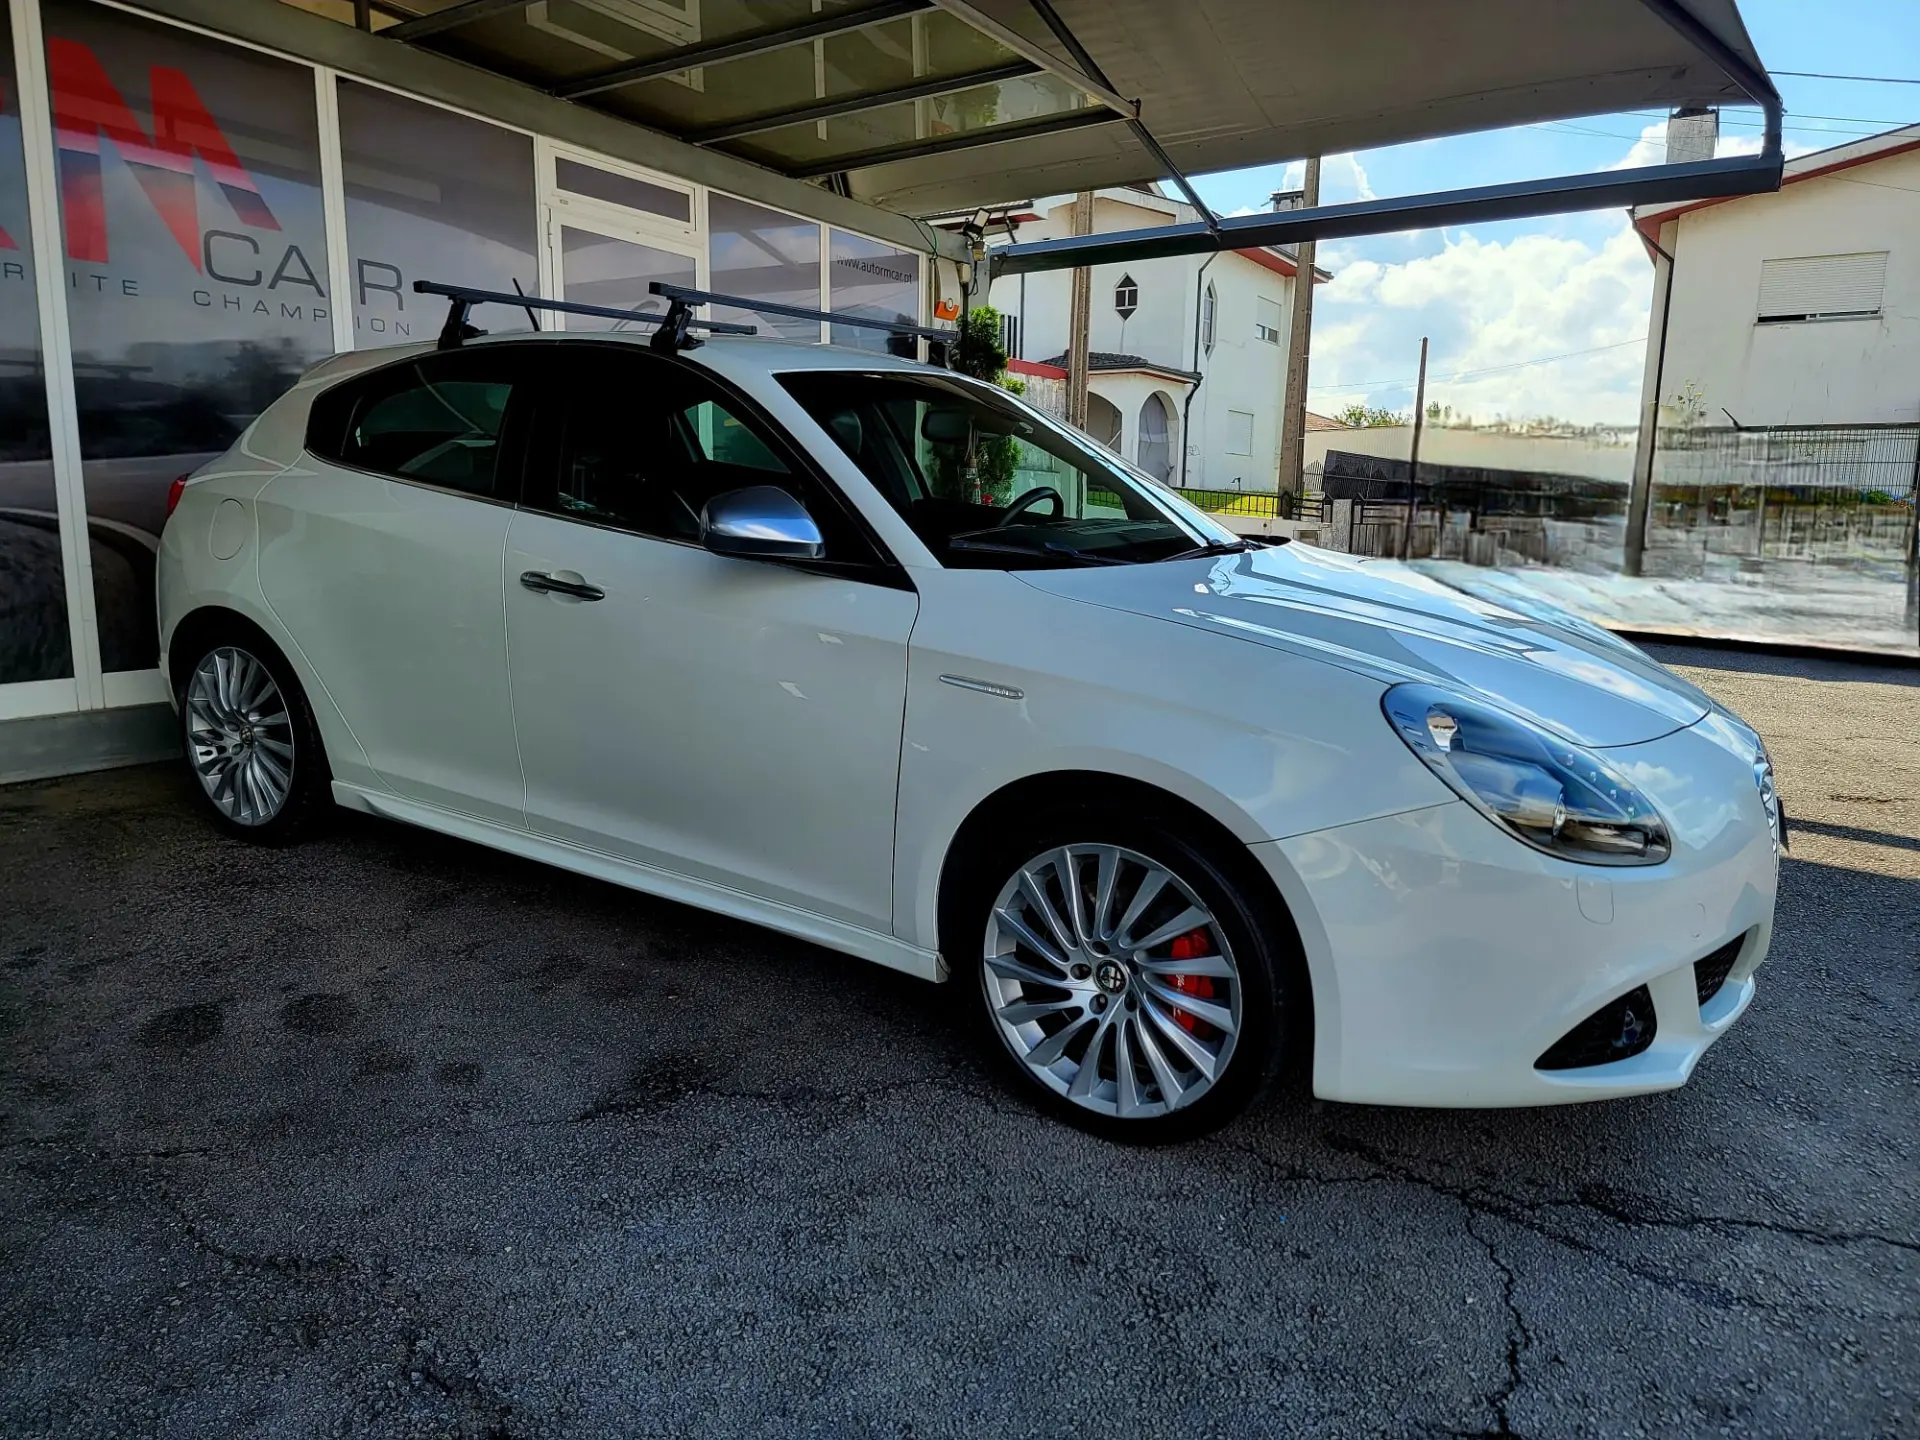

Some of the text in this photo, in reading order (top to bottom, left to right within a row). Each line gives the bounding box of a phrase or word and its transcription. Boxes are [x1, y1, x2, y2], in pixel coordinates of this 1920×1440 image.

[203, 229, 404, 311] CAR
[836, 253, 913, 285] www.autormcar.pt
[193, 290, 411, 337] CHAMPION
